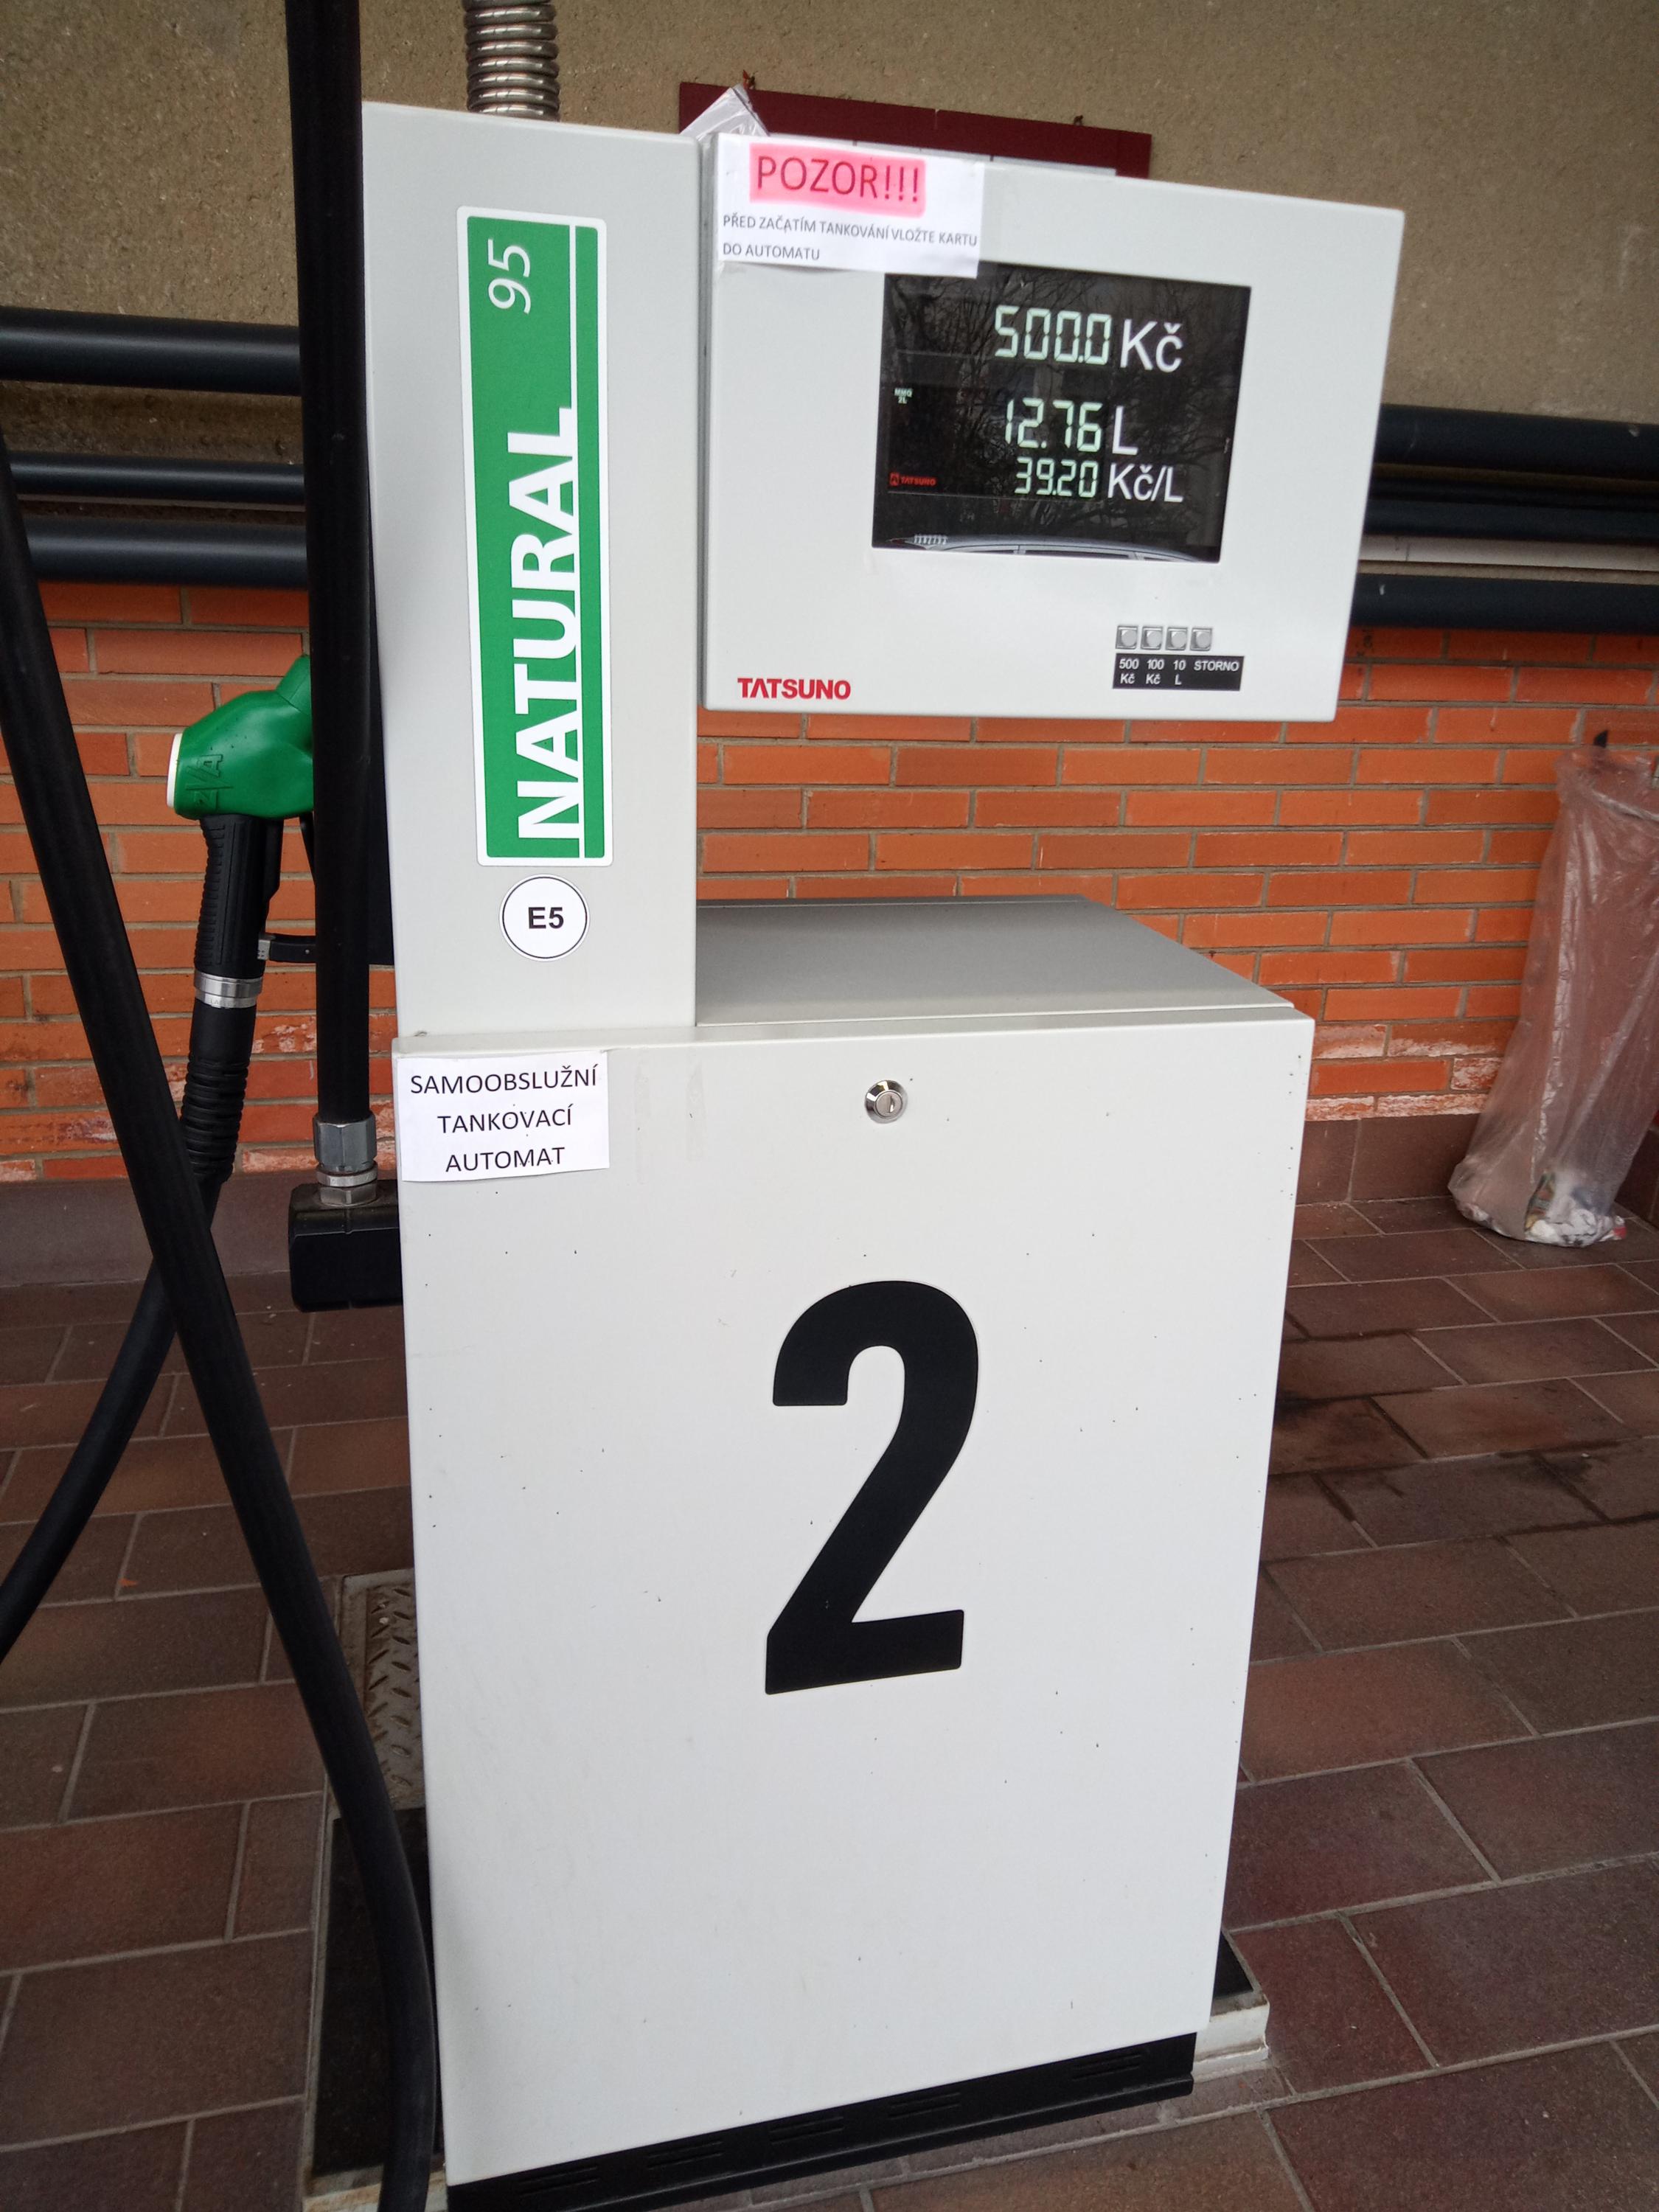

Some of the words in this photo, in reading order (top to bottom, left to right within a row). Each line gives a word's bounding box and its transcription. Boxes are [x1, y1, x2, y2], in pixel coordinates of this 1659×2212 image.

[757, 156, 919, 203] POZOR!!!
[723, 212, 756, 228] PŘED
[759, 215, 815, 232] ZAČATÍM
[820, 220, 889, 240] TANKOVÁNÍ
[891, 226, 935, 243] VLOŽTE
[939, 232, 978, 247] KARTU
[723, 243, 742, 256] DO
[745, 245, 821, 260] AUTOMATU
[487, 239, 532, 315] 95
[1119, 318, 1184, 372] Kč
[1004, 397, 1104, 453] 12.76
[1112, 406, 1138, 456] L
[901, 476, 936, 486] TATSUNO
[1014, 456, 1099, 498] 39.20
[1107, 463, 1183, 502] Kč/L
[508, 407, 580, 842] NATURAL
[1119, 658, 1139, 669] 500
[1147, 658, 1164, 670] 100
[1173, 659, 1186, 670] 10
[1193, 661, 1239, 671] STORNO
[737, 678, 851, 700] TATSUNO
[1120, 673, 1135, 684] Kč
[1146, 674, 1161, 685] Kč
[1175, 675, 1182, 685] L
[528, 906, 564, 929] E5
[410, 1063, 599, 1094] SAMOOBSLUŽNÍ
[437, 1103, 574, 1133] TANKOVACÍ
[445, 1147, 566, 1172] AUTOMAT
[765, 1280, 978, 1695] 2
